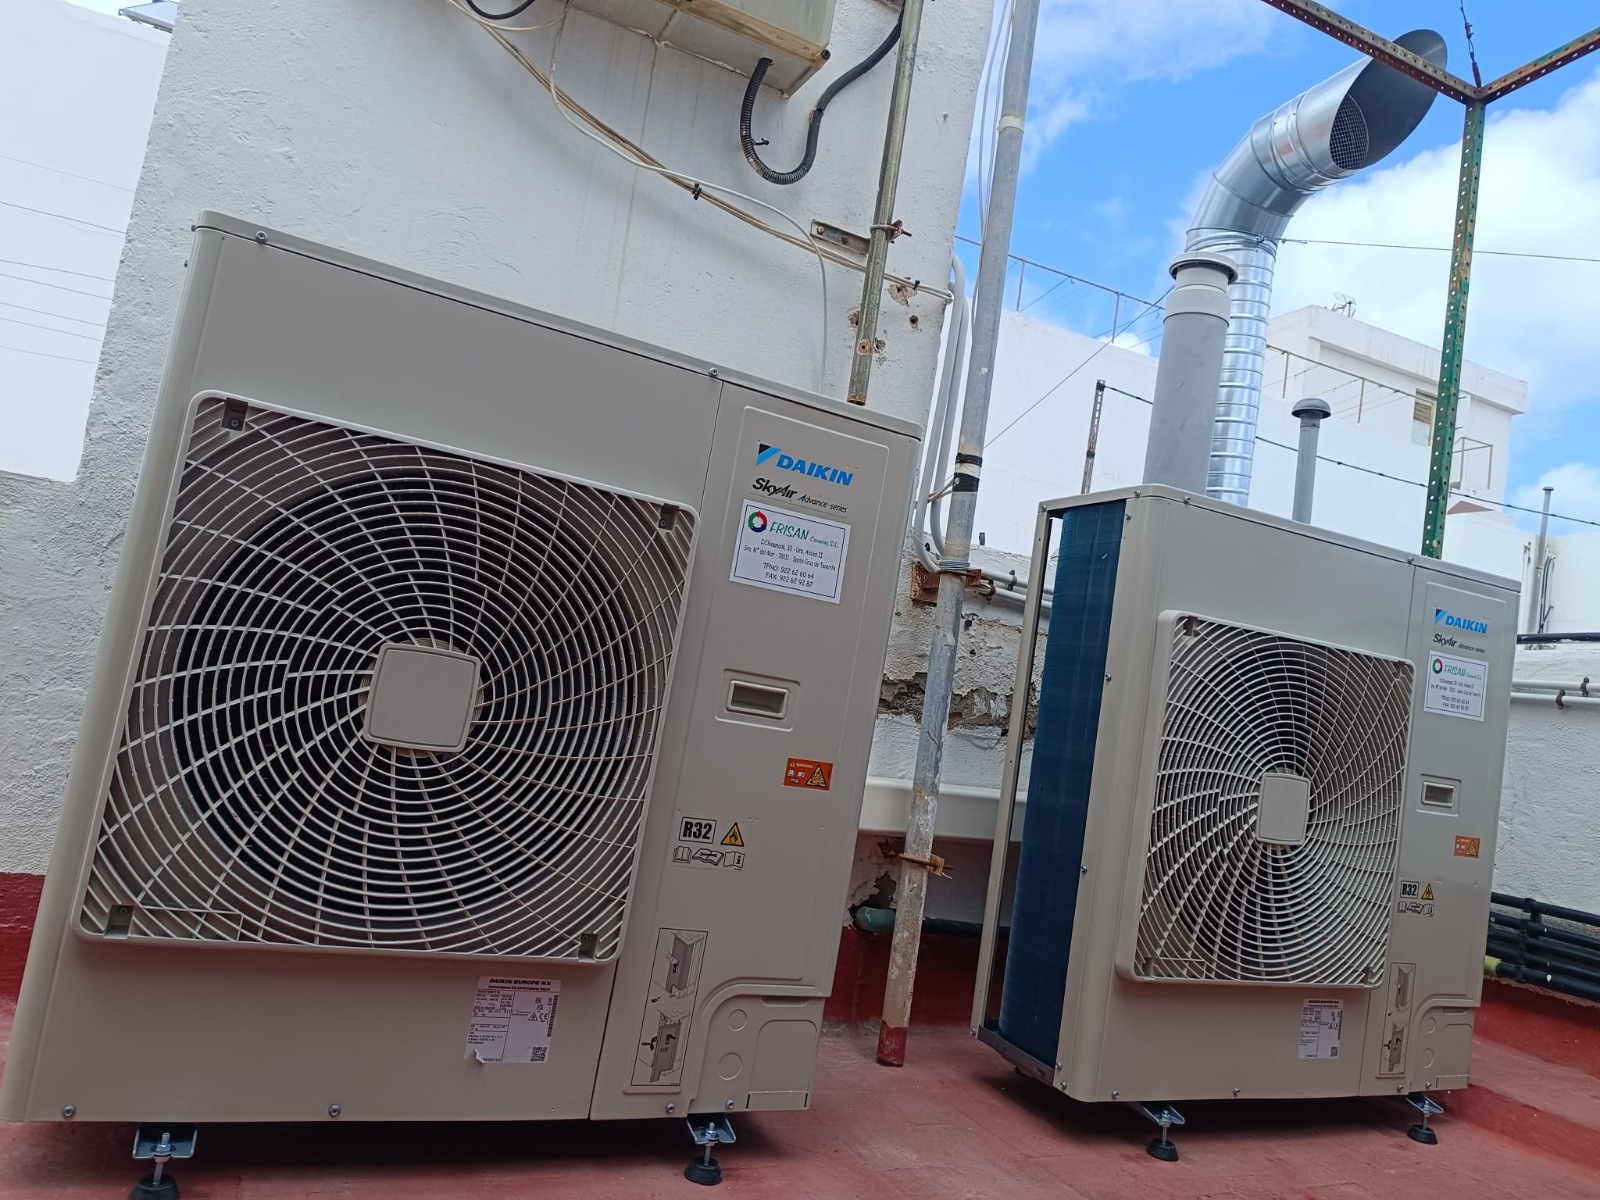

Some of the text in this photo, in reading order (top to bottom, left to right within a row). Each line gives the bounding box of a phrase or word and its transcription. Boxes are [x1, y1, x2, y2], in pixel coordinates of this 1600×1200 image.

[776, 454, 853, 486] DAIKIN
[752, 477, 849, 513] SkyAir Advance-series
[769, 522, 809, 540] FRISAN
[779, 574, 790, 583] 922
[780, 566, 791, 575] 922
[799, 570, 807, 578] 60
[1445, 615, 1488, 634] DAIKIN
[683, 821, 712, 839] R32
[1402, 883, 1417, 896] R32
